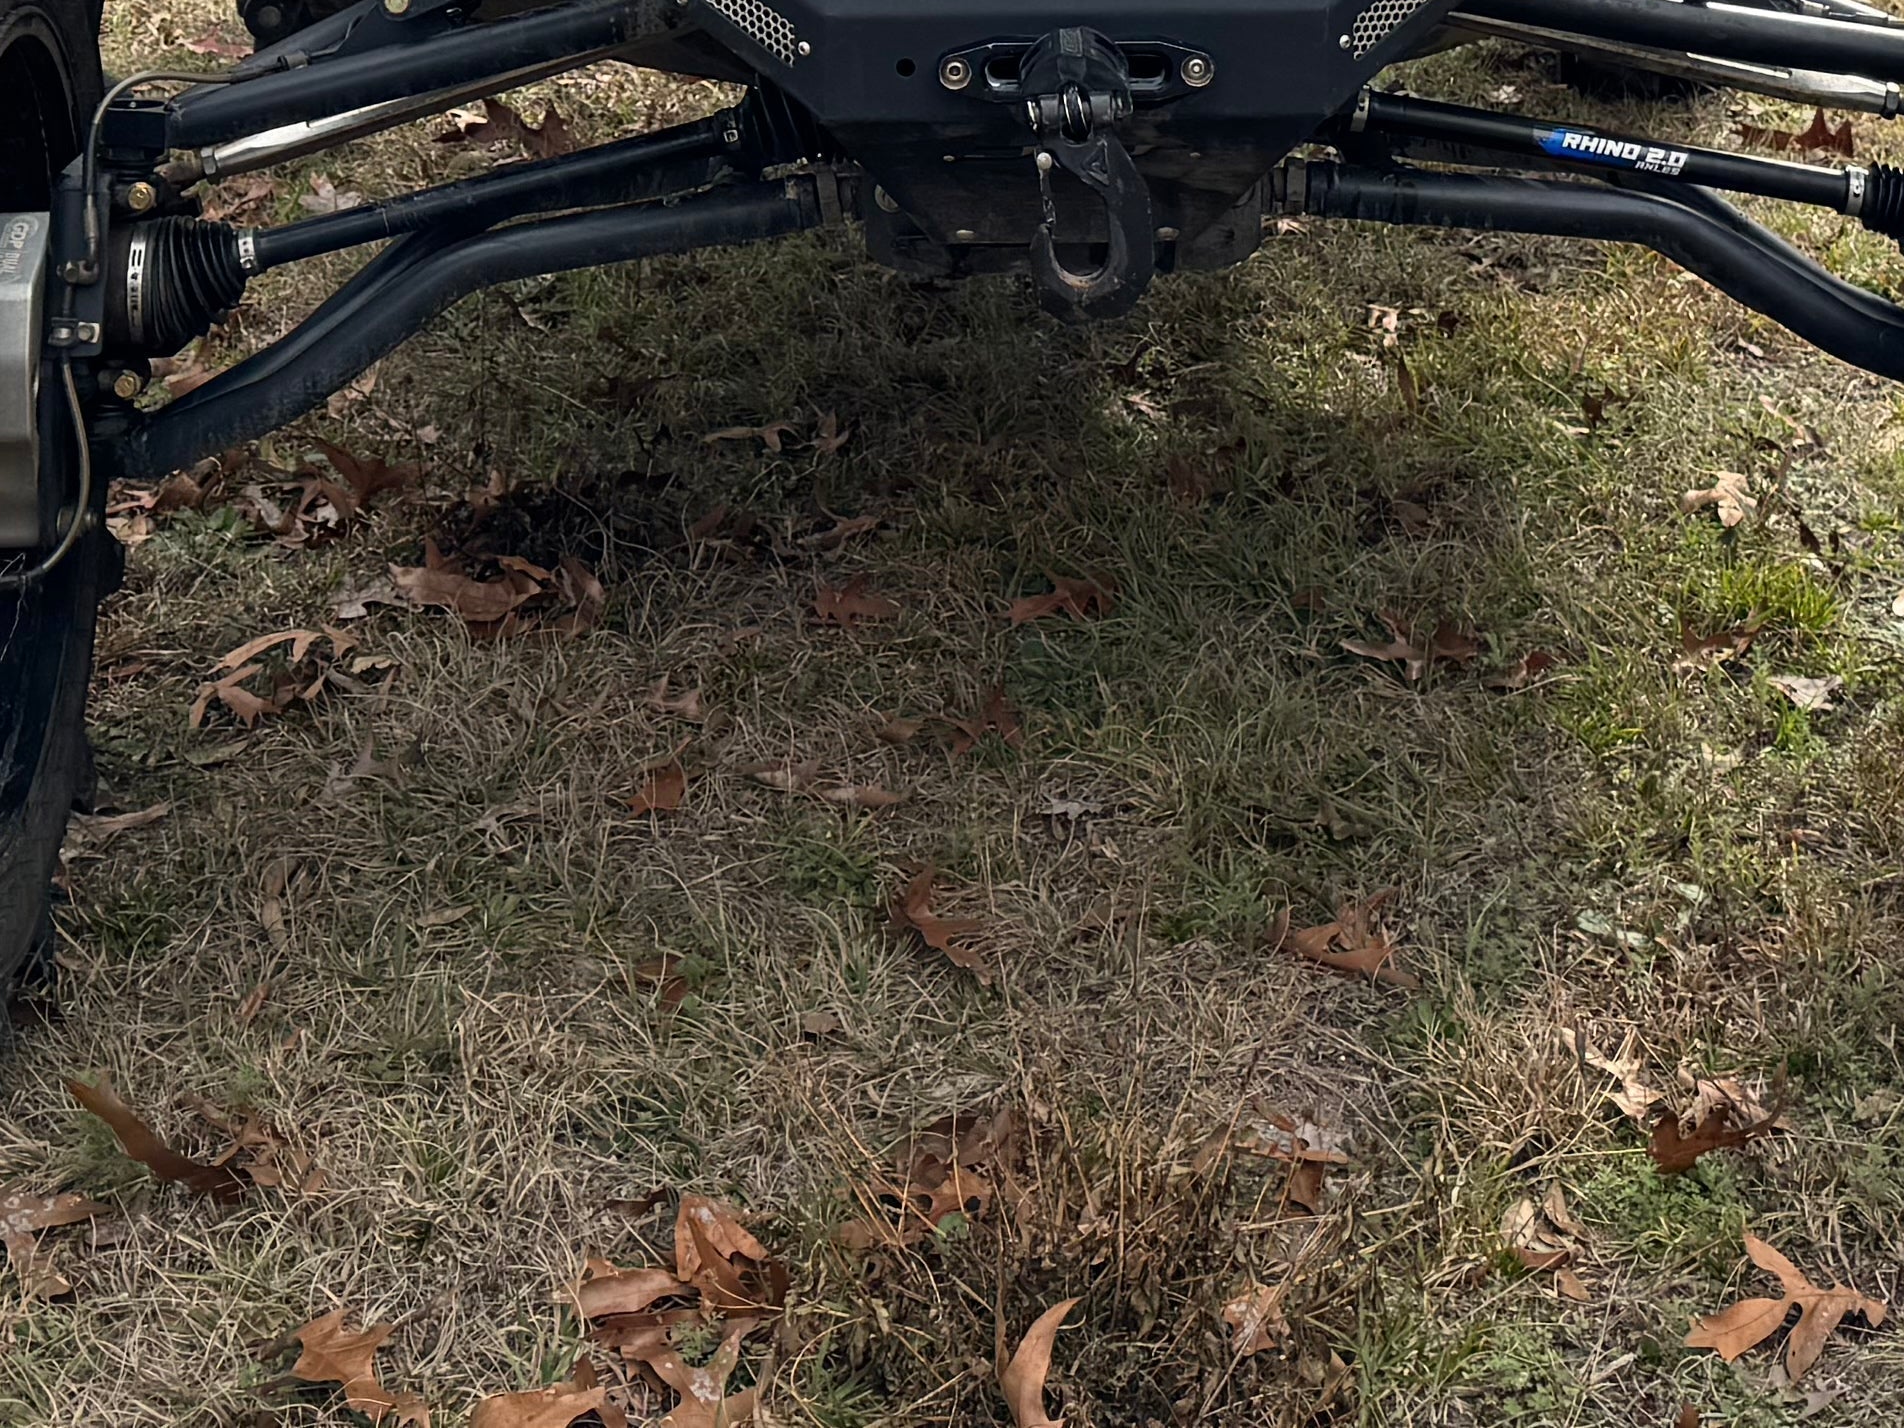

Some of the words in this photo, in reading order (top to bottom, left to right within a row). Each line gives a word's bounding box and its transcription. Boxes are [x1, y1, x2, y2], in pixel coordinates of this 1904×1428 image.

[1562, 132, 1642, 161] RHINO
[1645, 147, 1689, 168] 2.0
[8, 222, 29, 249] GDP
